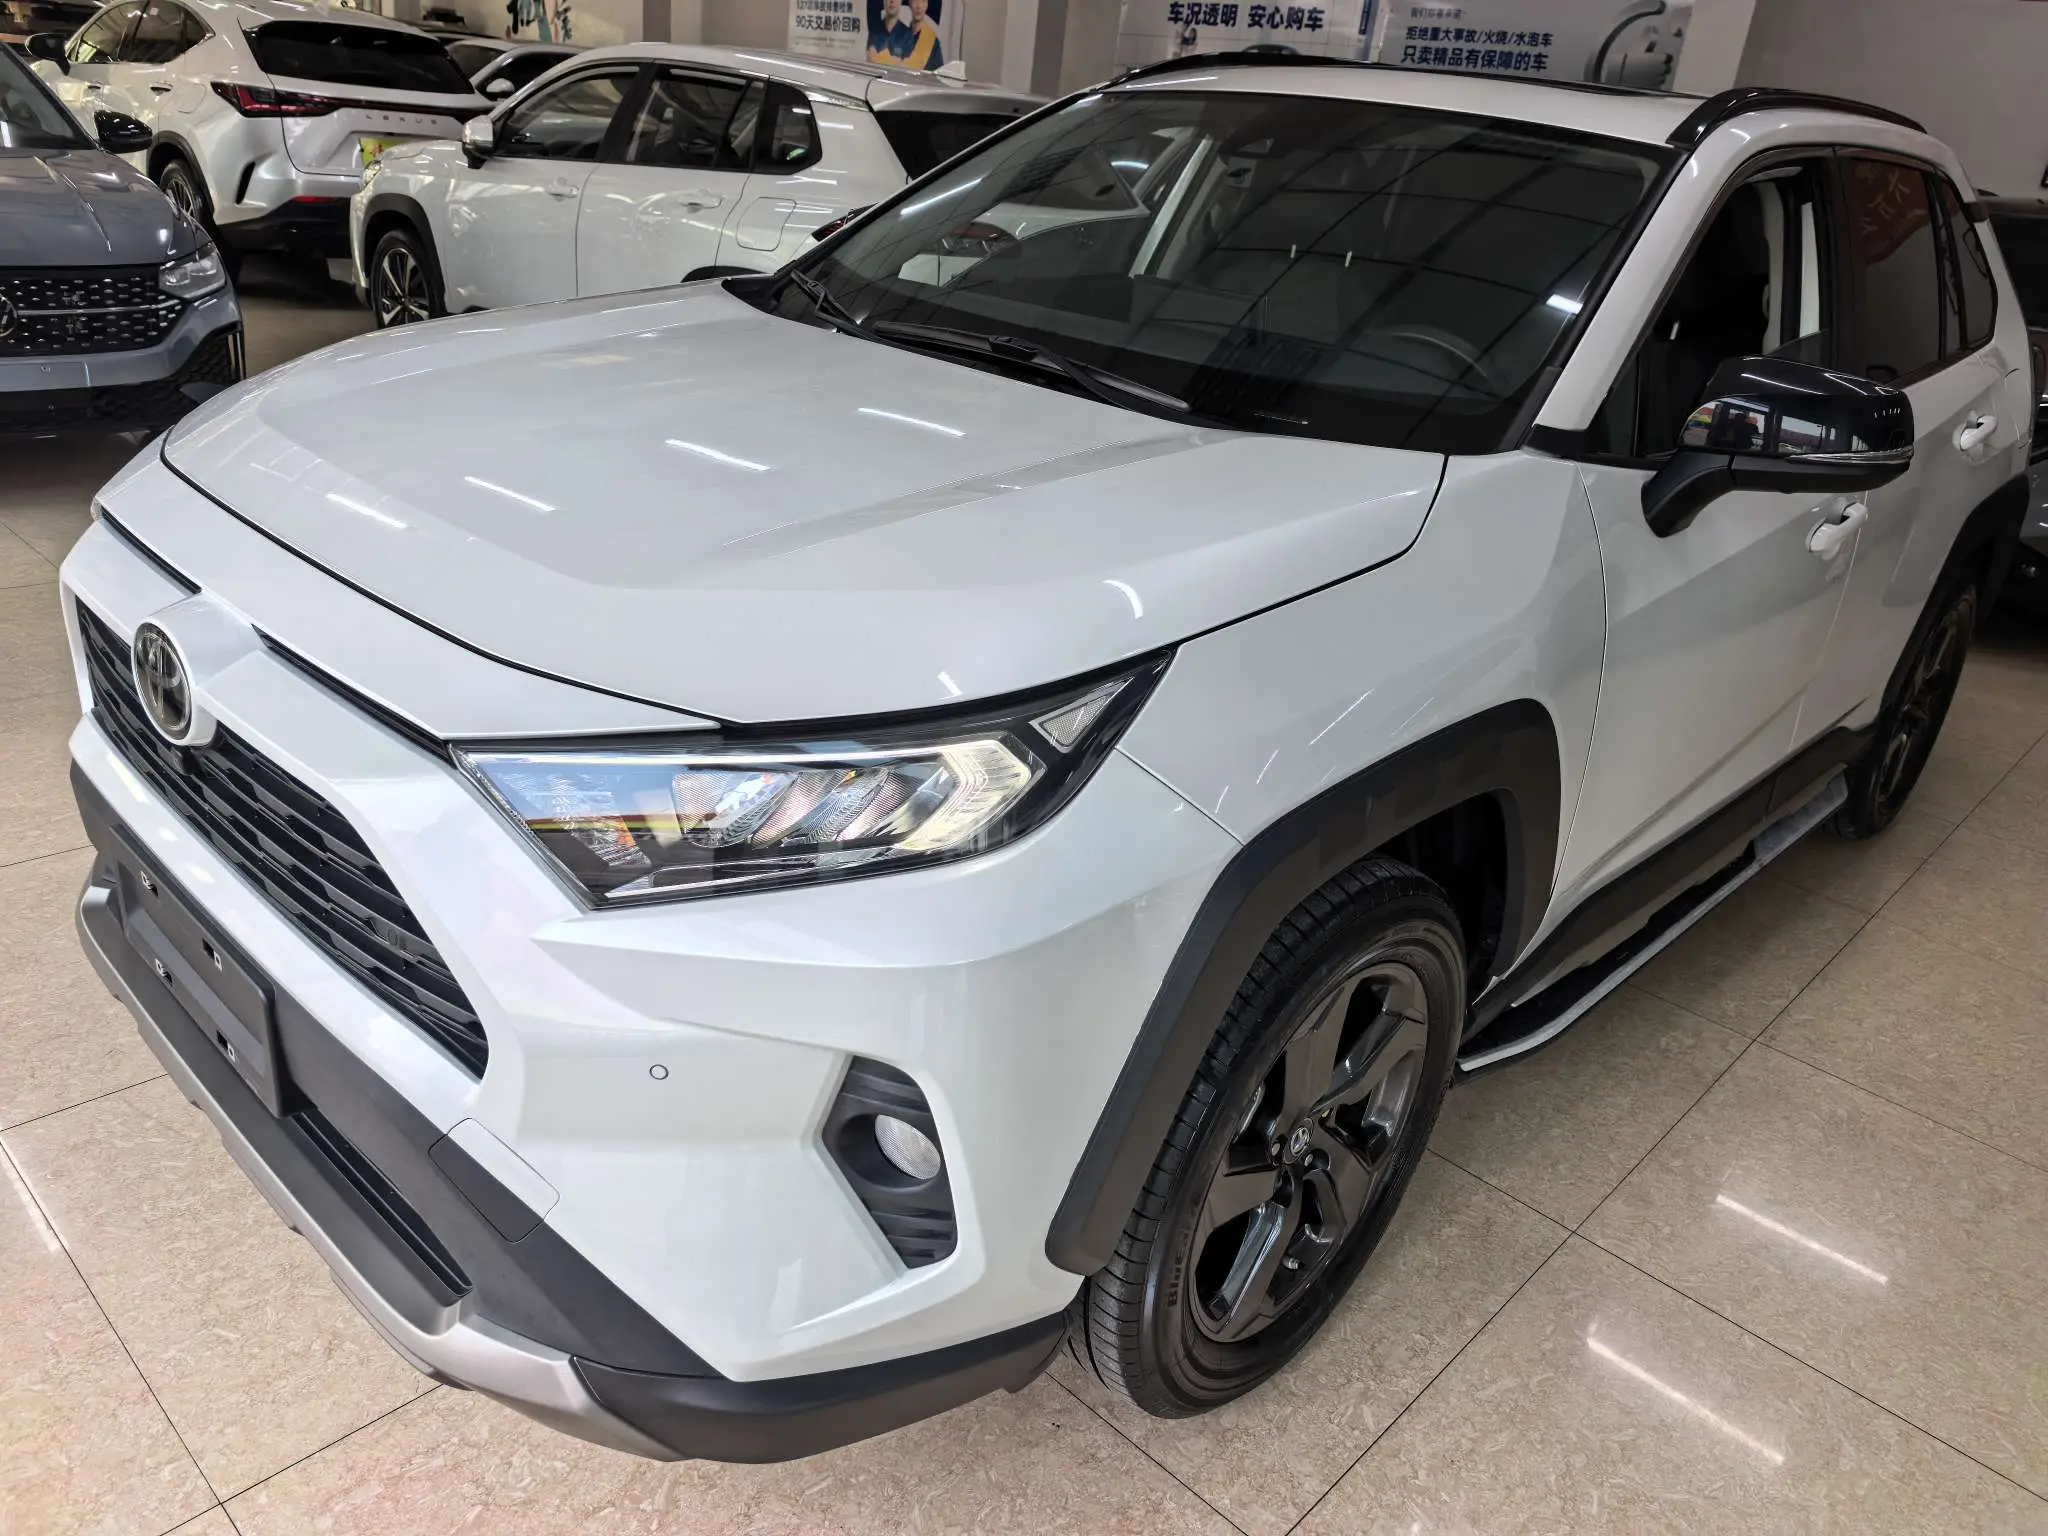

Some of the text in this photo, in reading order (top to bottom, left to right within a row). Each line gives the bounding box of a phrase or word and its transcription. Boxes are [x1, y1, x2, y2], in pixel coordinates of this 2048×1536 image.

[796, 15, 861, 34] 90天交易价回购
[1168, 1, 1325, 32] 车况透明 安心购车
[1405, 26, 1554, 48] 拒绝重大事故/火烧/水泡车
[1400, 45, 1550, 72] 只卖精品有保障的车
[366, 113, 438, 125] LEXUS
